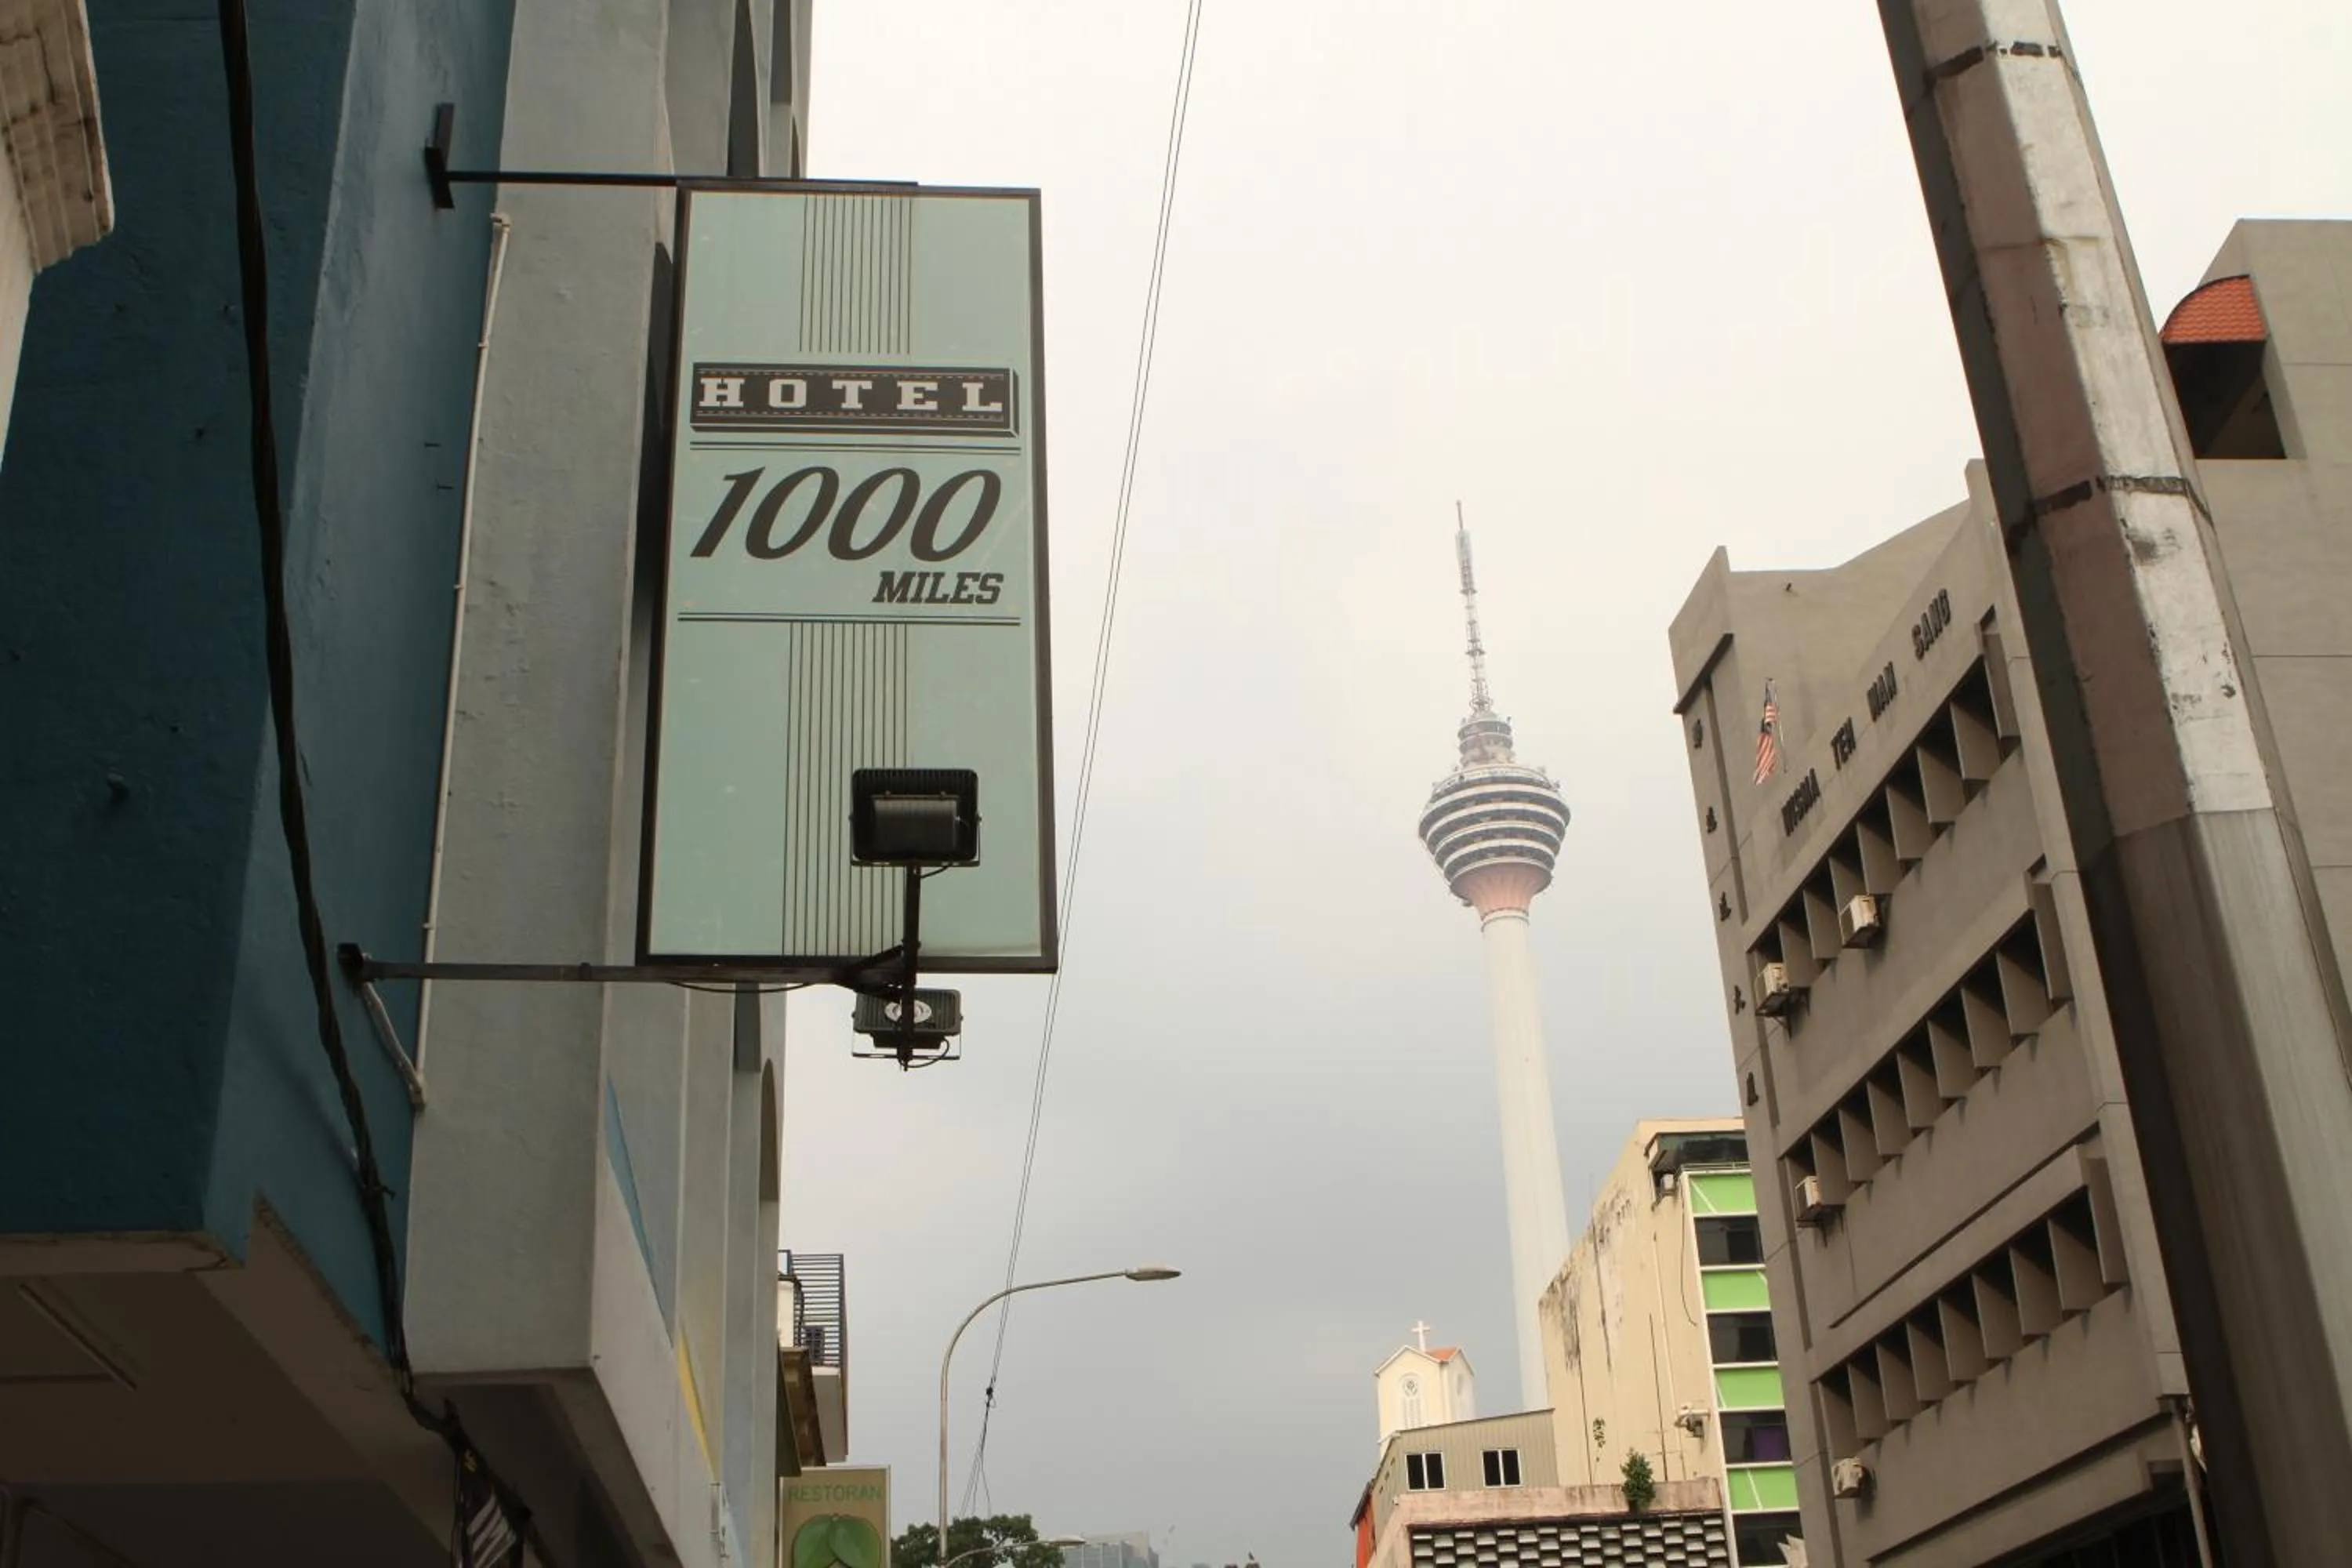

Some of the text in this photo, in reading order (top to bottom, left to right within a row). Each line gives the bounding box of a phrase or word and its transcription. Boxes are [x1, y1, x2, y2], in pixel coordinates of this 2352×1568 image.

[699, 376, 1003, 412] HOTEL
[690, 466, 1002, 562] 1000
[872, 571, 1004, 604] MILES
[1831, 717, 1857, 771] TEH
[1866, 661, 1898, 722] WAN
[1911, 588, 1952, 660] SANG
[789, 1483, 882, 1502] RESTORAN
